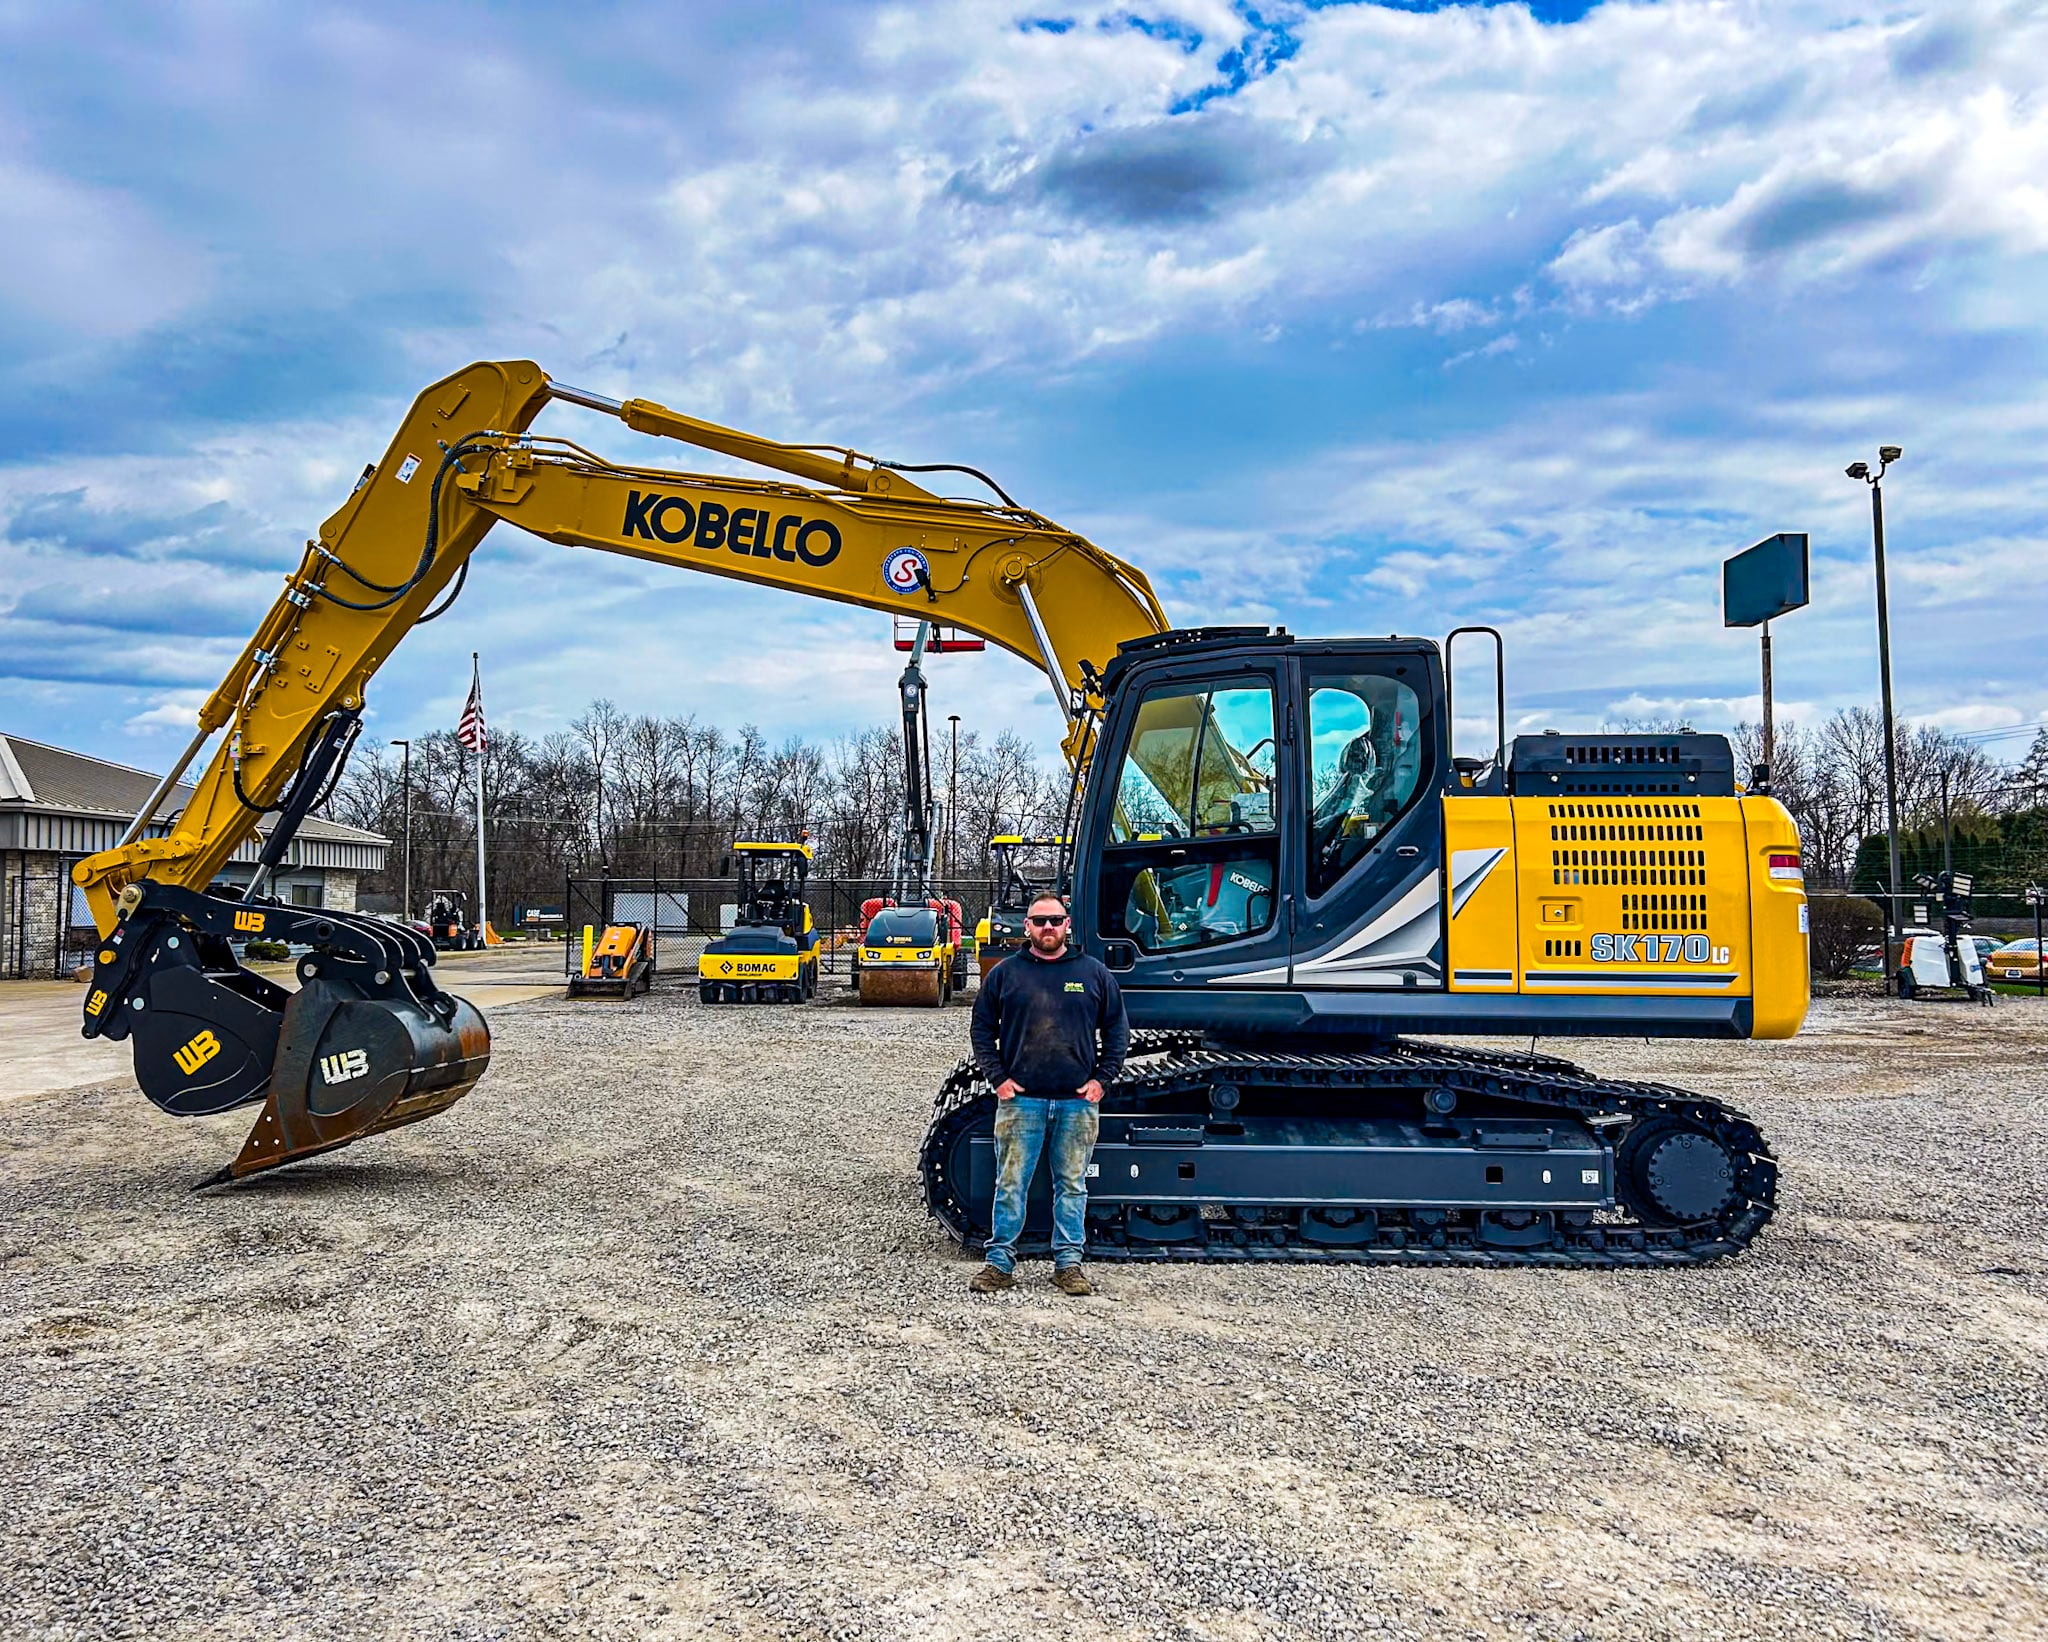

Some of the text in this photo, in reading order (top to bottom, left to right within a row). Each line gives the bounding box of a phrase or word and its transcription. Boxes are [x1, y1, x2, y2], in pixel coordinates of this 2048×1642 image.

[622, 490, 842, 567] KOBELCO
[1591, 933, 1729, 964] SK170 LC
[736, 963, 776, 973] BOMAG
